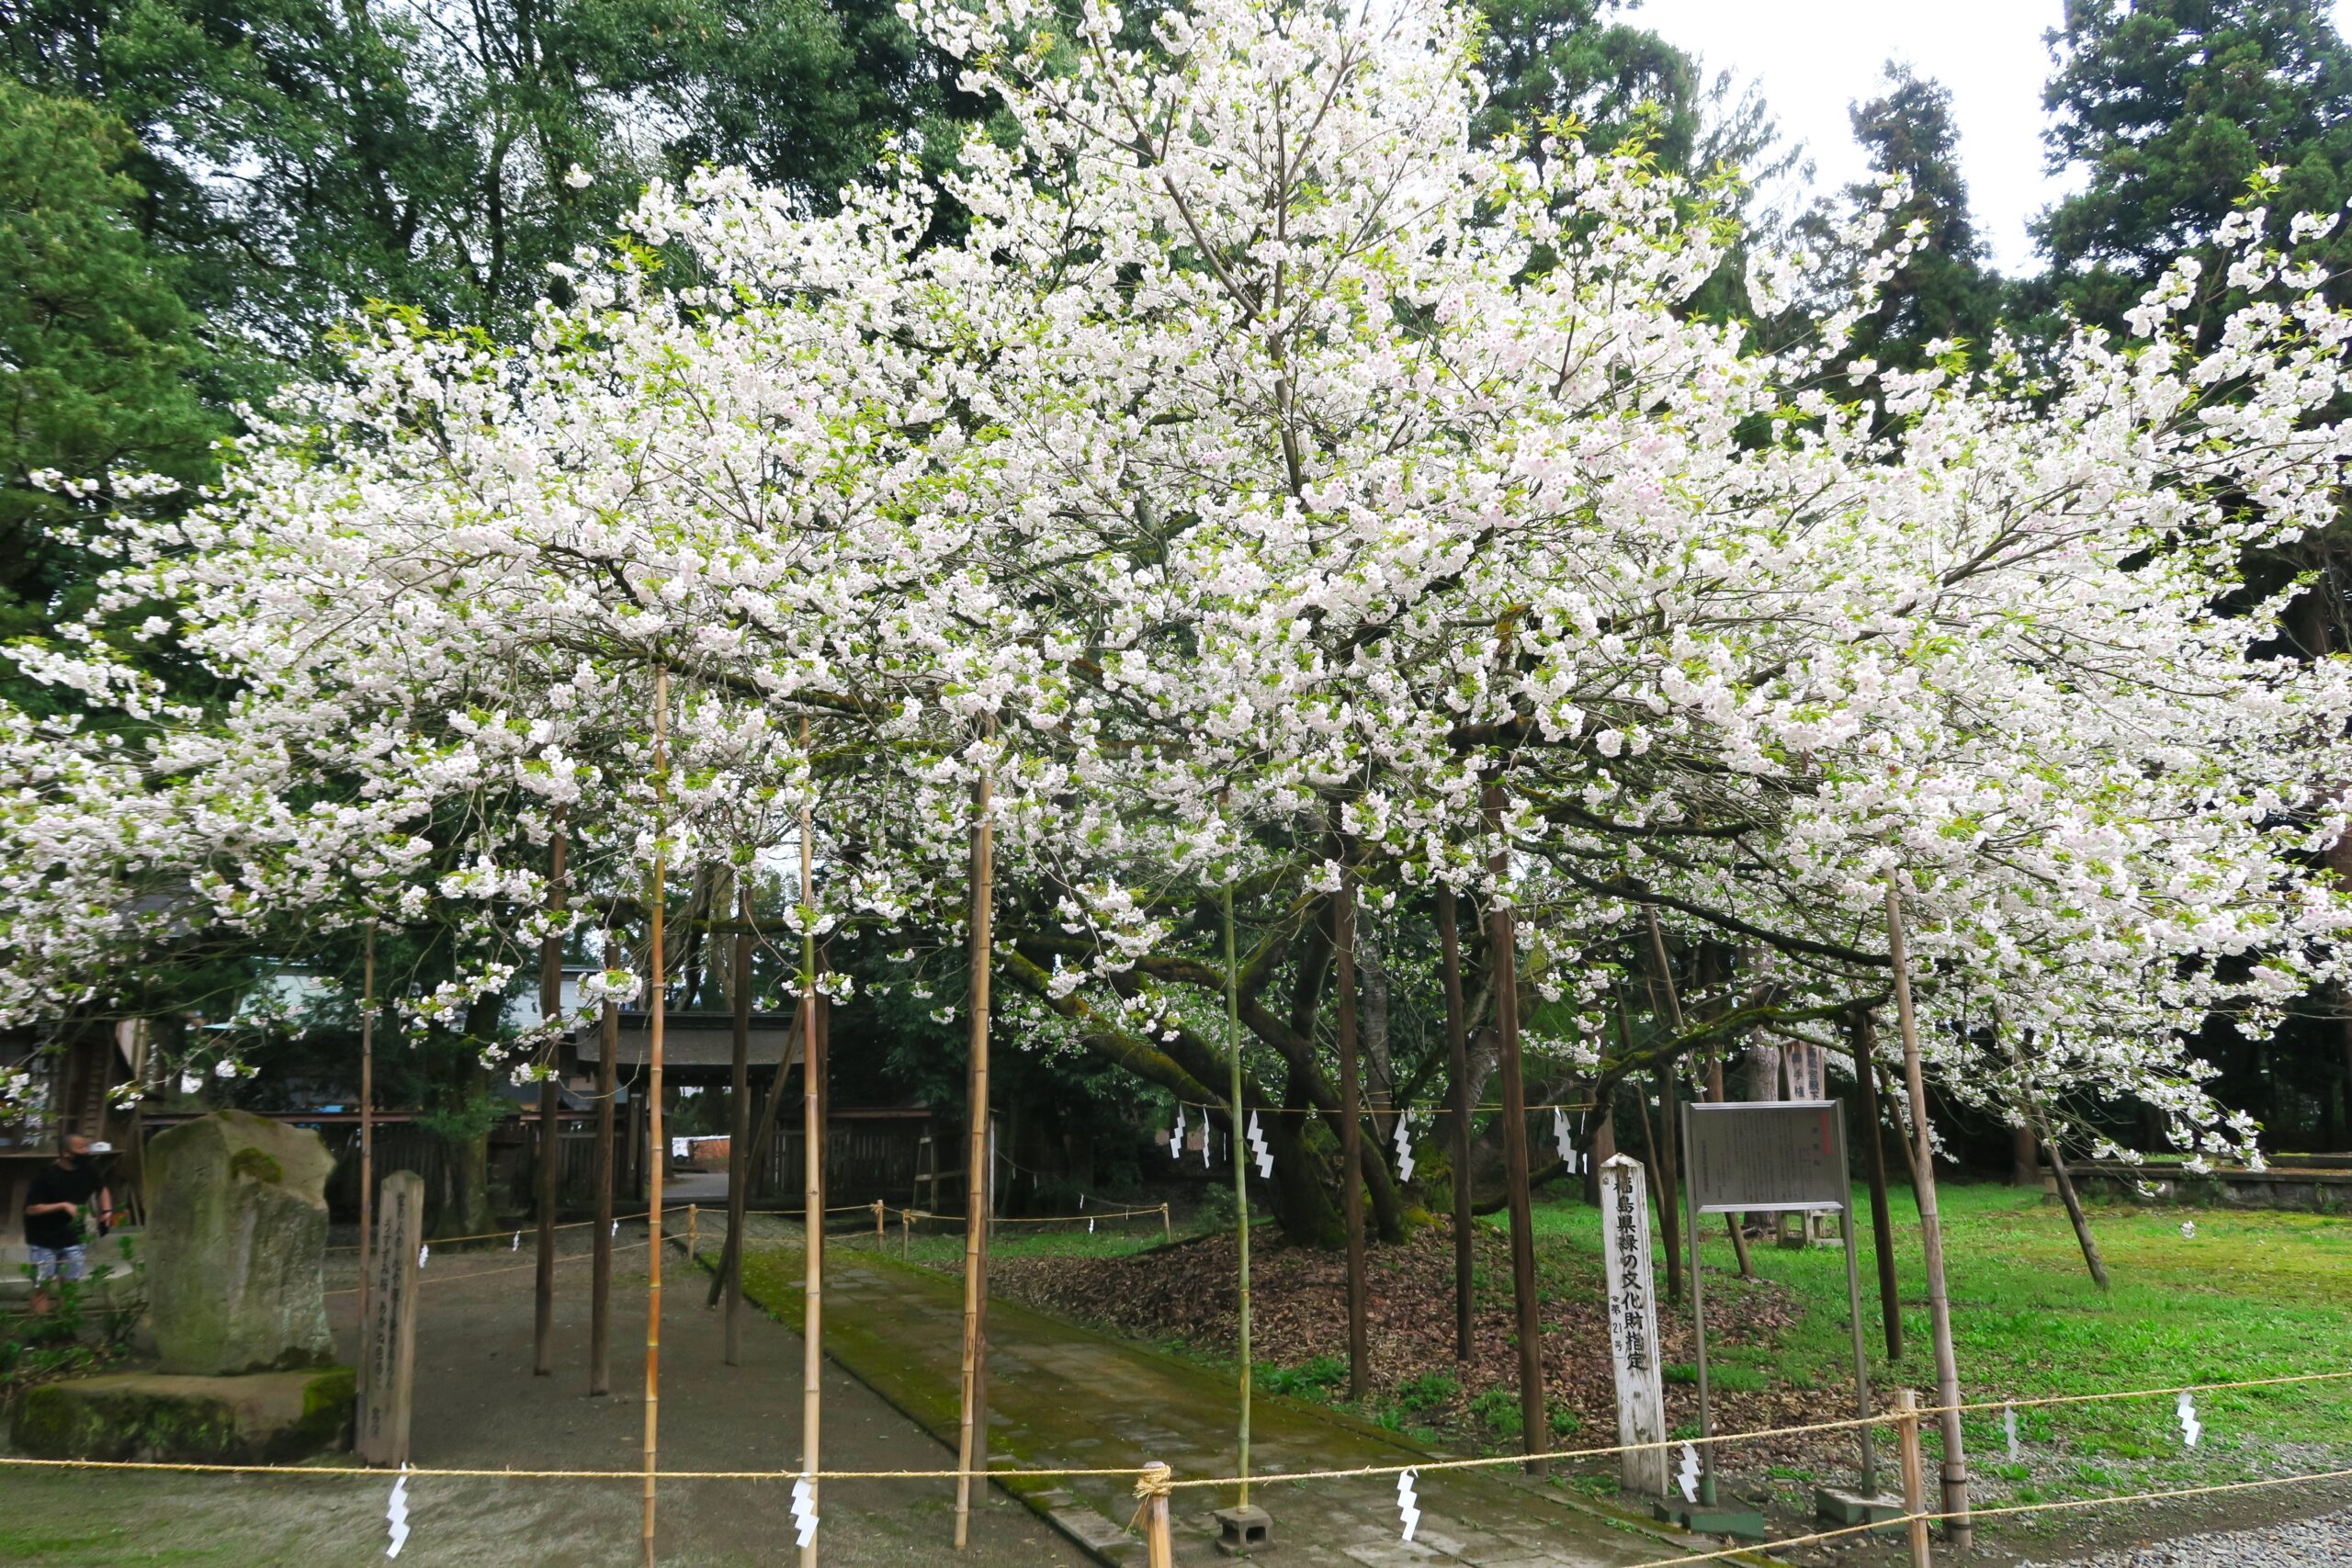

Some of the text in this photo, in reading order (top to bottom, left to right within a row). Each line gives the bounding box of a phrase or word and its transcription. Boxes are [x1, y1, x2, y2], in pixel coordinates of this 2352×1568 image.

[1613, 1176, 1649, 1371] 福島県緑の文化財指定
